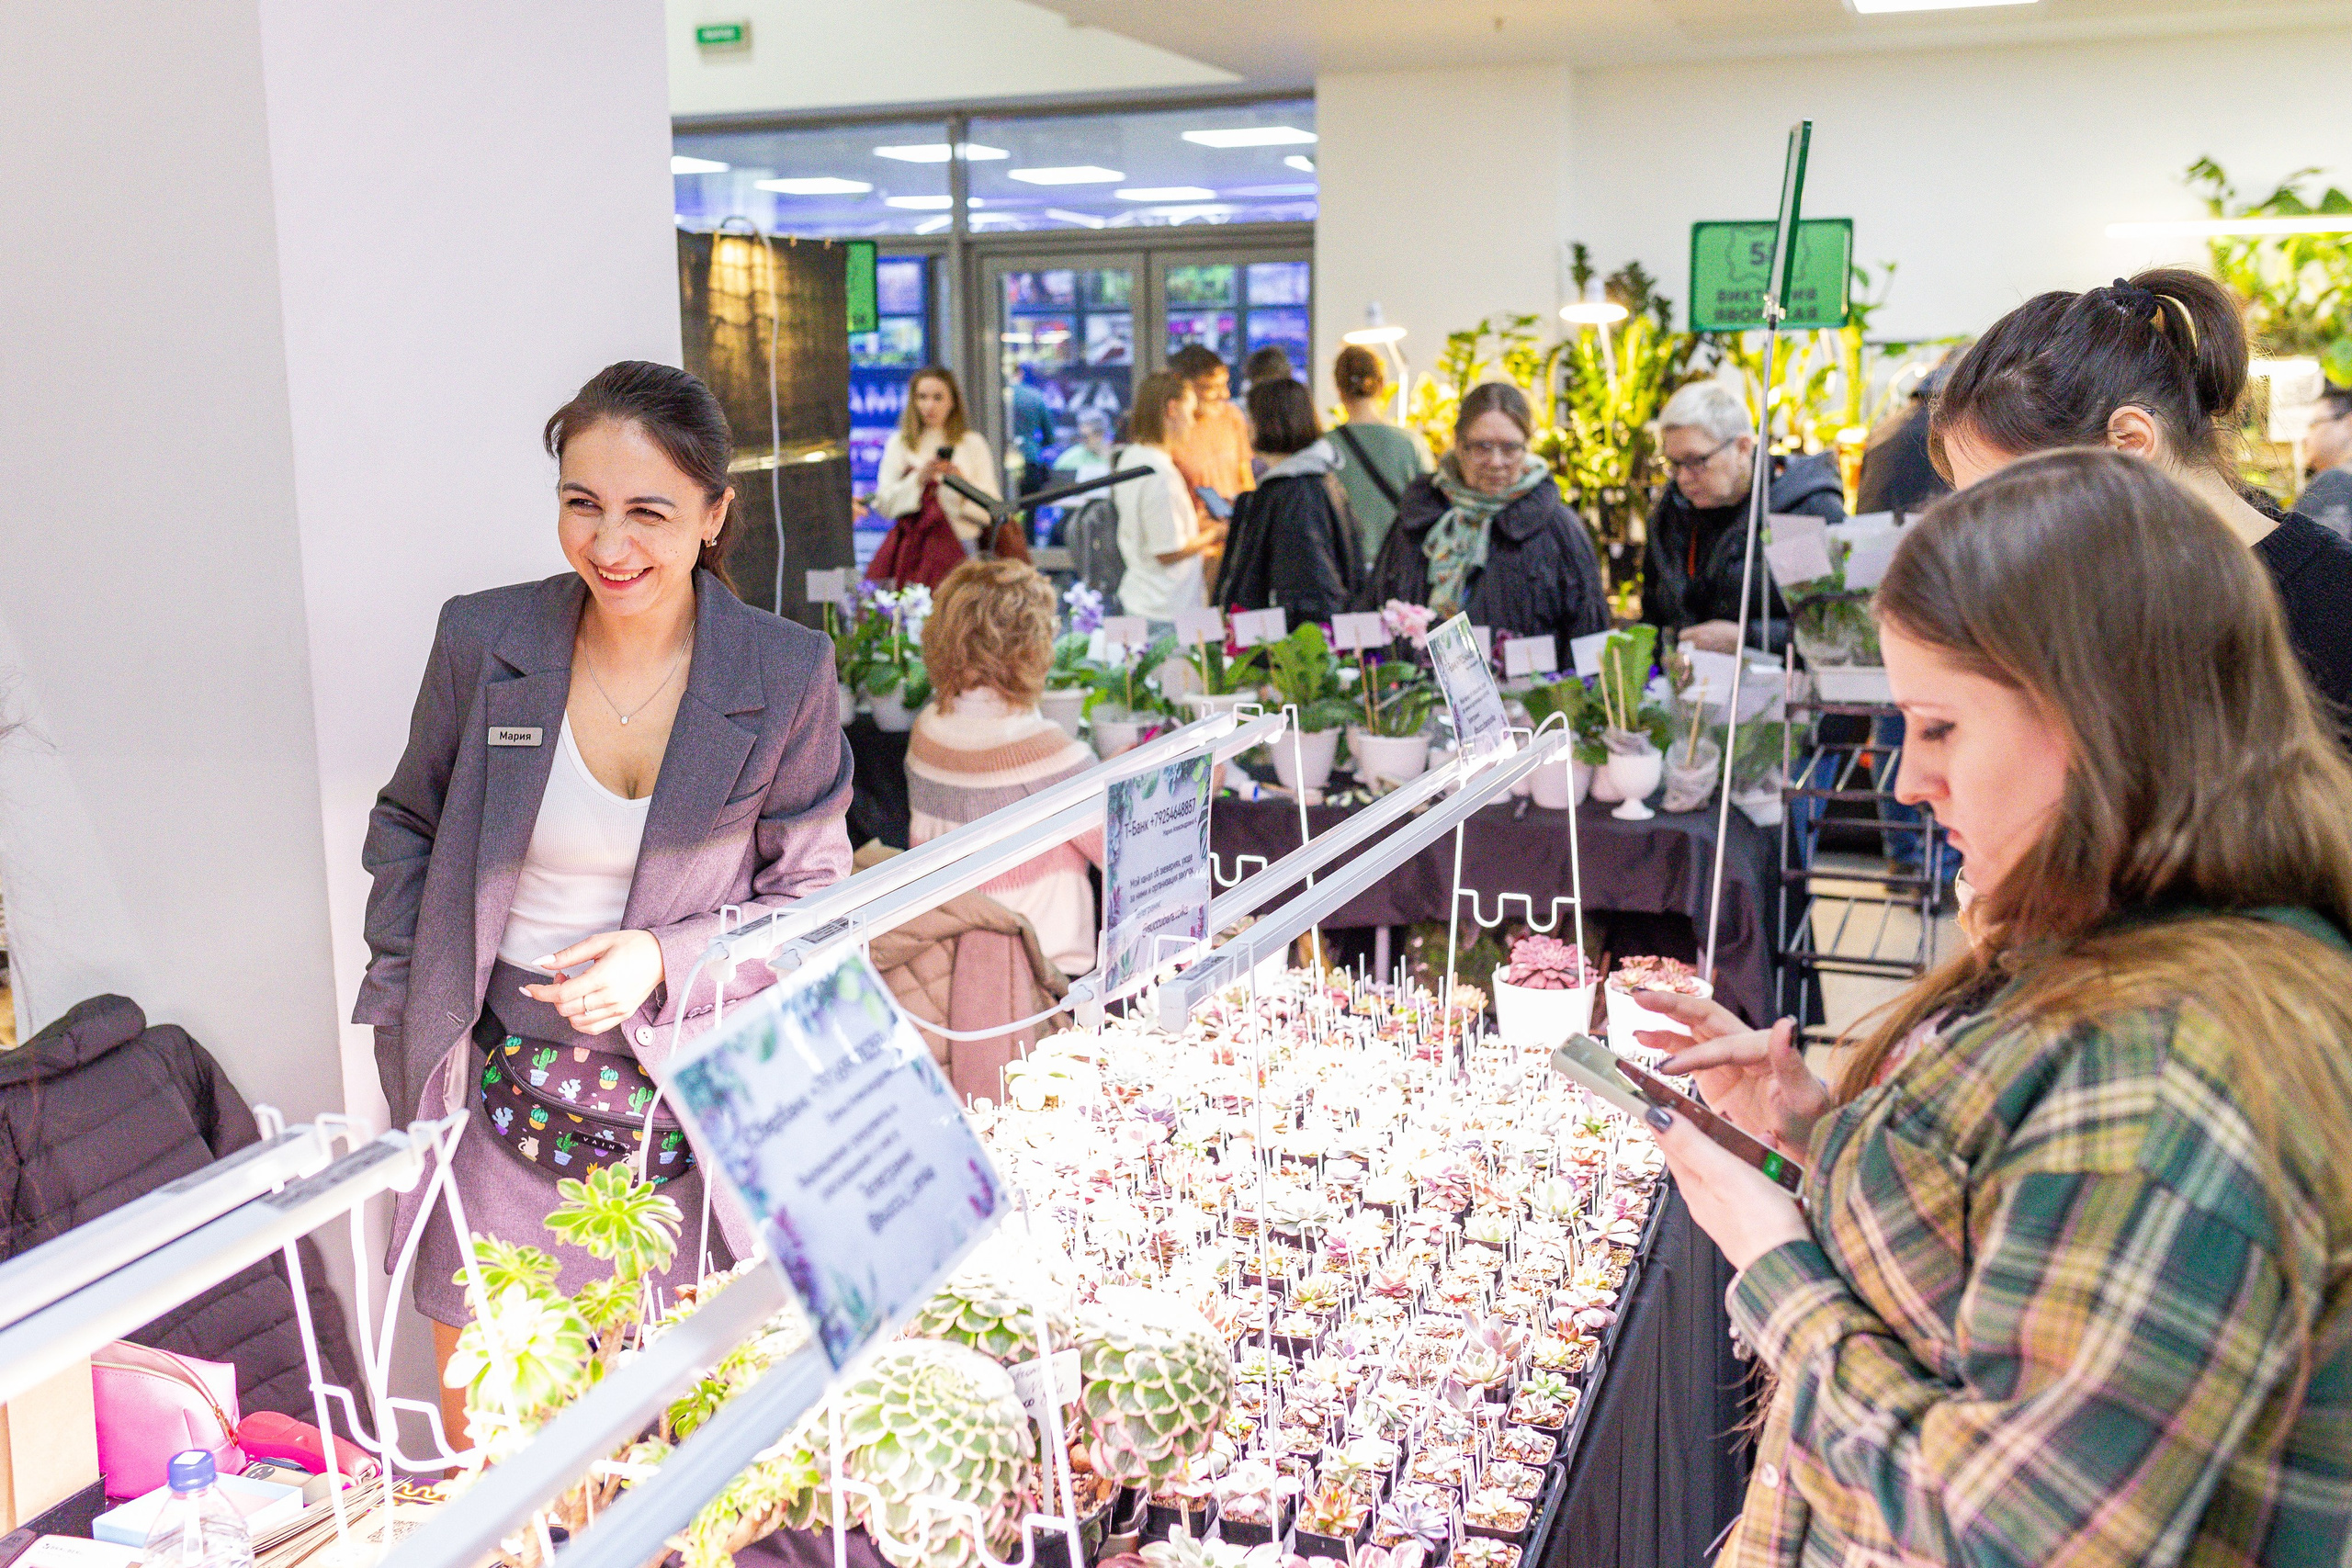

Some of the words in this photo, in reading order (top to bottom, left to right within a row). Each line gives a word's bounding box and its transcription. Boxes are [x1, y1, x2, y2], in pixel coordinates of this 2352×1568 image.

[499, 731, 531, 742] Мария
[1125, 819, 1148, 838] Т-Банк
[1150, 797, 1196, 827] +79254648857
[582, 1136, 616, 1150] VAIN
